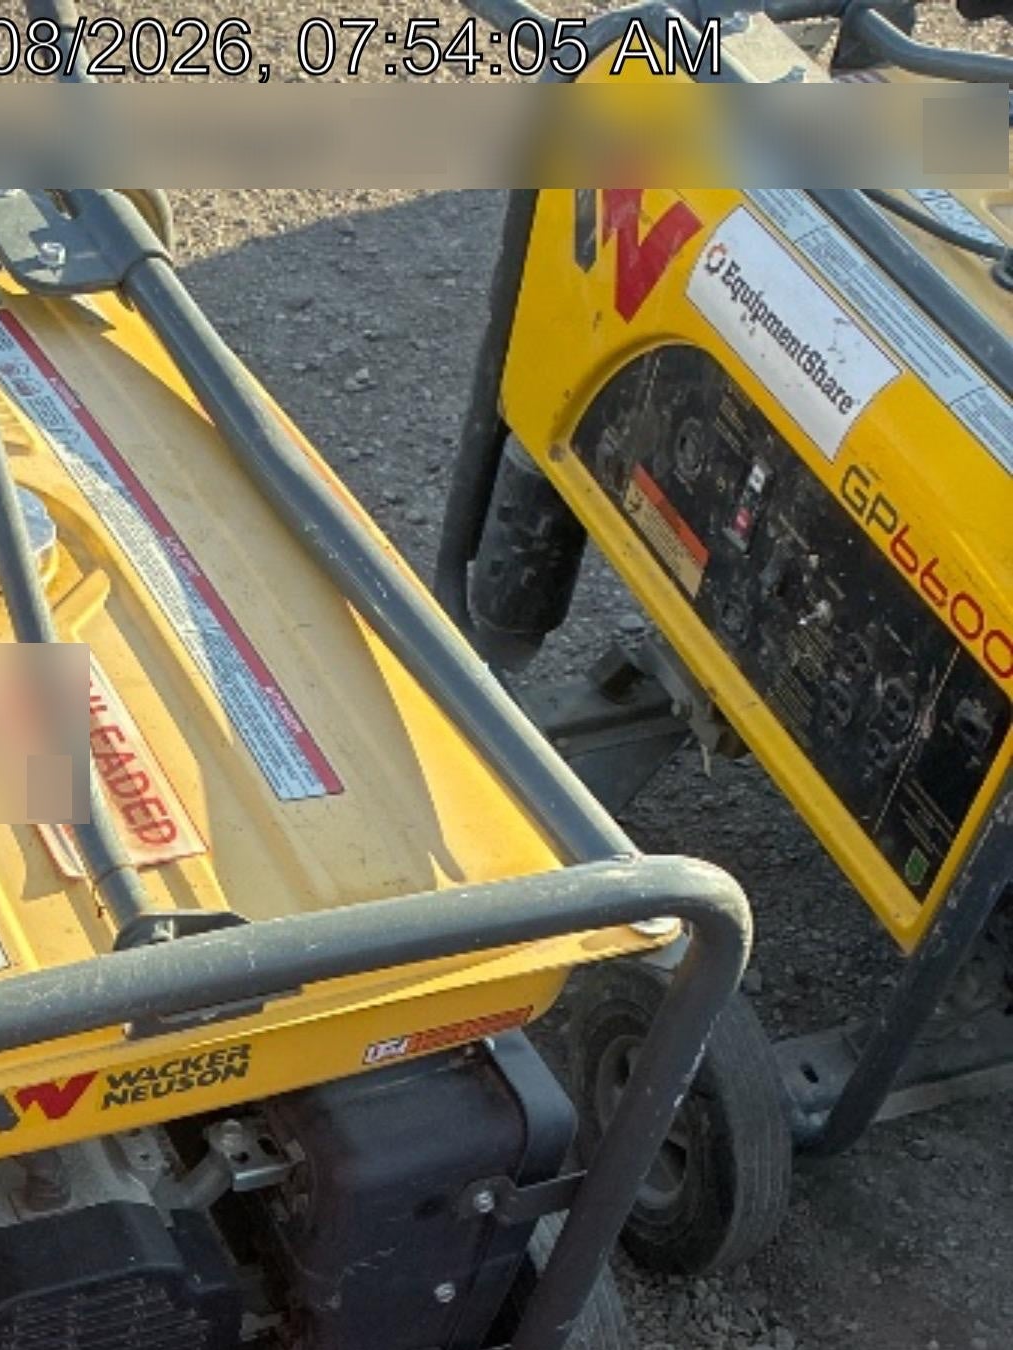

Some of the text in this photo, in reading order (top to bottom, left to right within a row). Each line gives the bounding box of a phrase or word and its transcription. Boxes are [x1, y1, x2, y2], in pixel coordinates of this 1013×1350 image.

[721, 260, 855, 416] EquipmentShare
[840, 464, 1013, 679] GP6600
[101, 1061, 249, 1110] NEUSON
[106, 1044, 252, 1090] WACKER
